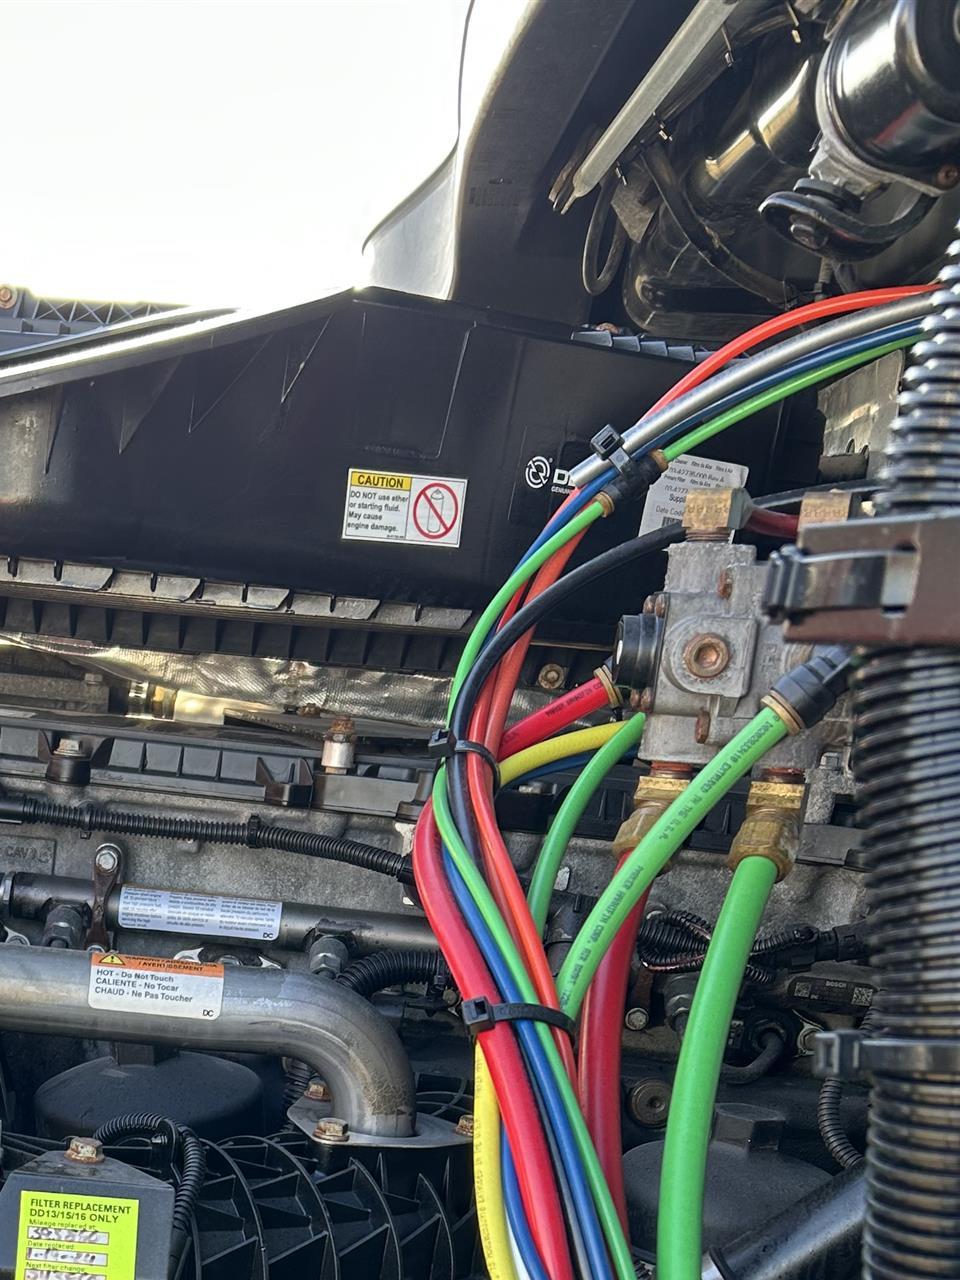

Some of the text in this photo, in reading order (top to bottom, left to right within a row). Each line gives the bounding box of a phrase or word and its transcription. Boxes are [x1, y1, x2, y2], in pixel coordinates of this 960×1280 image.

[358, 475, 404, 488] CAUTION
[358, 503, 382, 512] starting
[384, 503, 400, 512] fluid.
[348, 512, 362, 521] May
[347, 522, 398, 532] engine damage.
[96, 969, 114, 977] HOT
[121, 970, 133, 979] Do
[134, 972, 149, 981] Not
[149, 973, 174, 983] Touch
[95, 978, 137, 988] CALIENTE
[156, 983, 179, 991] Tocar
[94, 987, 124, 996] CHAUD
[131, 990, 142, 998] Ne
[144, 991, 159, 1000] Pas
[161, 992, 193, 1002] Toucher
[202, 1009, 214, 1017] DC
[30, 1199, 131, 1214] FILTER REPLACEMENT
[30, 1209, 119, 1224] DD13/15/16 ONLY
